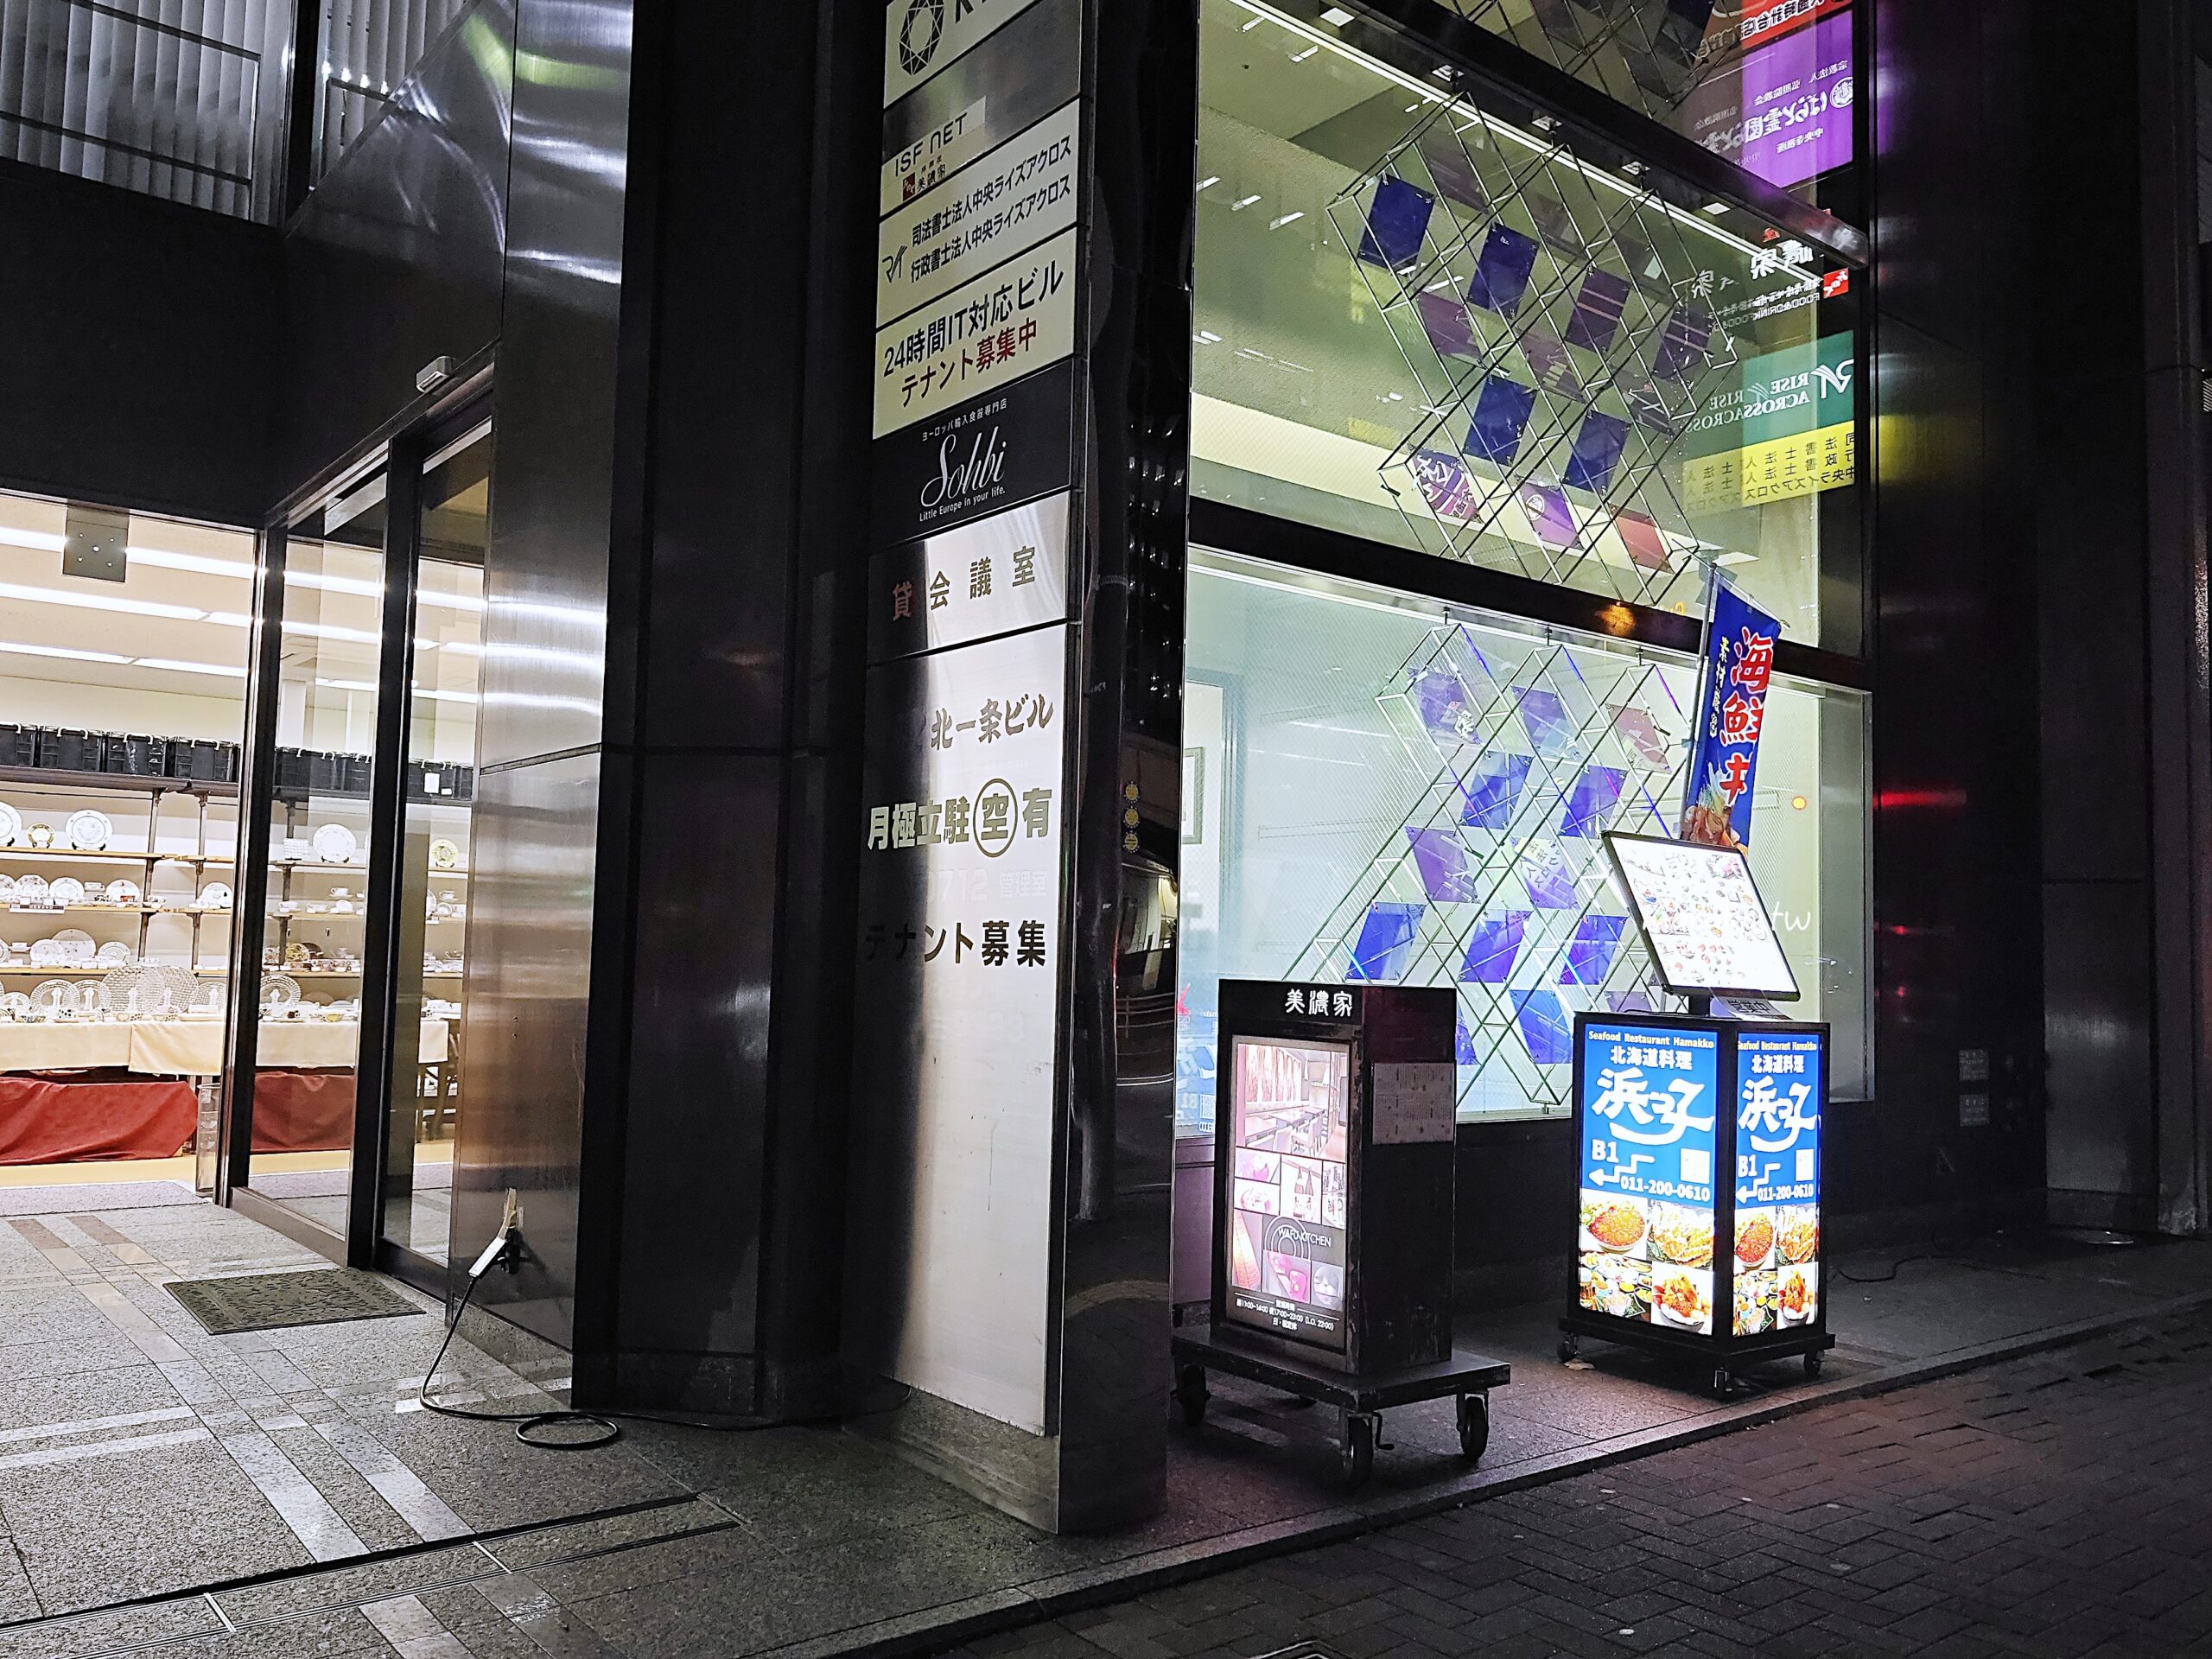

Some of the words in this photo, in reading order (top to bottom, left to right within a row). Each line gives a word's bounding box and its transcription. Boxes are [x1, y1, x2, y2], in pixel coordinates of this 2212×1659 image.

[894, 141, 924, 177] ISF
[911, 135, 1071, 247] 司法書士法人中央ライズアクロス
[910, 175, 1071, 283] 行政書士法人中央ライズアクロス
[882, 259, 1065, 378] 24時間IT対応ビル
[901, 317, 1038, 408] テナント募集中
[921, 397, 1008, 442] ヨーロッパ輸入食器専門店
[918, 502, 938, 522] Little
[939, 498, 962, 518] Europe
[964, 496, 971, 507] in
[973, 492, 988, 505] your
[991, 485, 1006, 499] life.
[892, 545, 1036, 621] 貸会議室
[930, 693, 1054, 751] 北一条ビル
[1284, 988, 1353, 1017] 美濃家
[1588, 1030, 1621, 1042] Seafood
[1624, 1033, 1671, 1046] Restaurant
[1673, 1037, 1714, 1049] Hamakko
[1610, 1046, 1693, 1071] 北海道料理
[1751, 1054, 1804, 1074] 北海道料理
[1592, 1139, 1619, 1164] B1
[1738, 1154, 1758, 1177] B1
[1619, 1176, 1711, 1202] 011-200-0610
[1758, 1183, 1814, 1202] 011-200-0610
